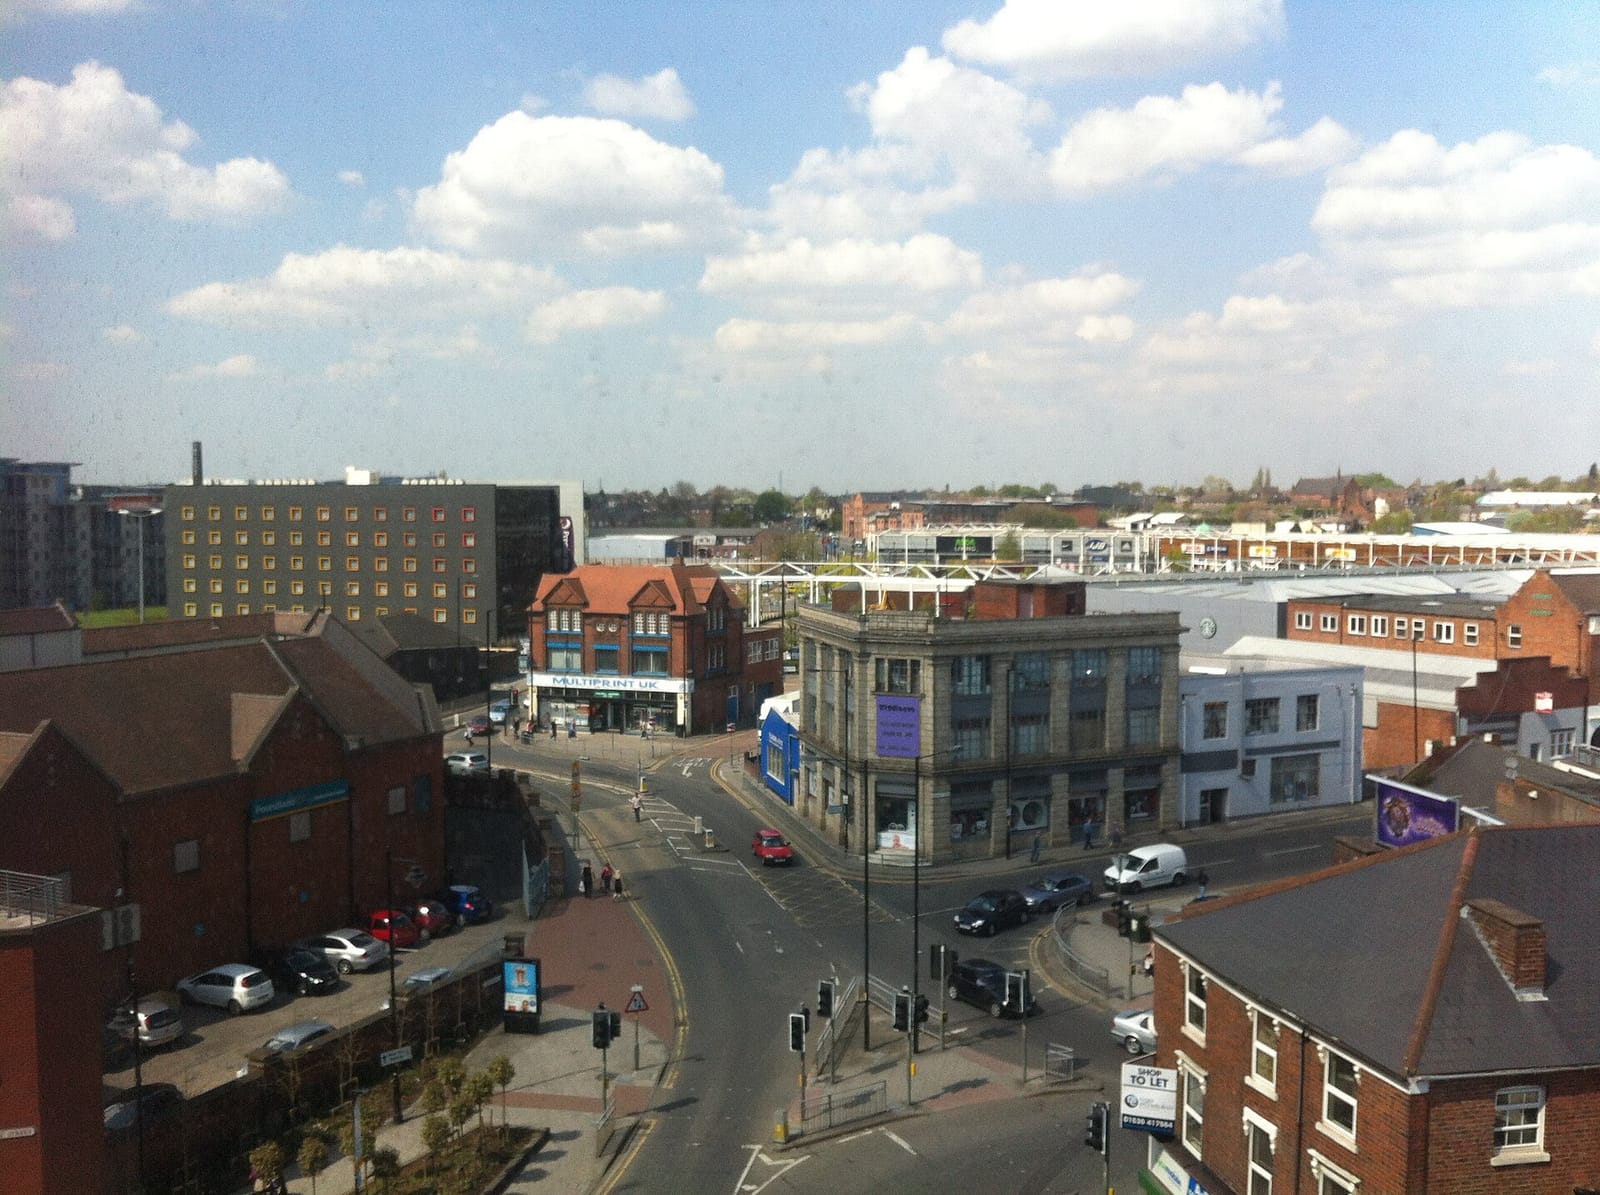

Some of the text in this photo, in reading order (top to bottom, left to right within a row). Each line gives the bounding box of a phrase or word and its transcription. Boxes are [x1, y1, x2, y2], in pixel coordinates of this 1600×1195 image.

[552, 677, 659, 689] MULTIPRINT UK
[1138, 1068, 1162, 1076] SHOP
[1131, 1075, 1168, 1088] TO LET
